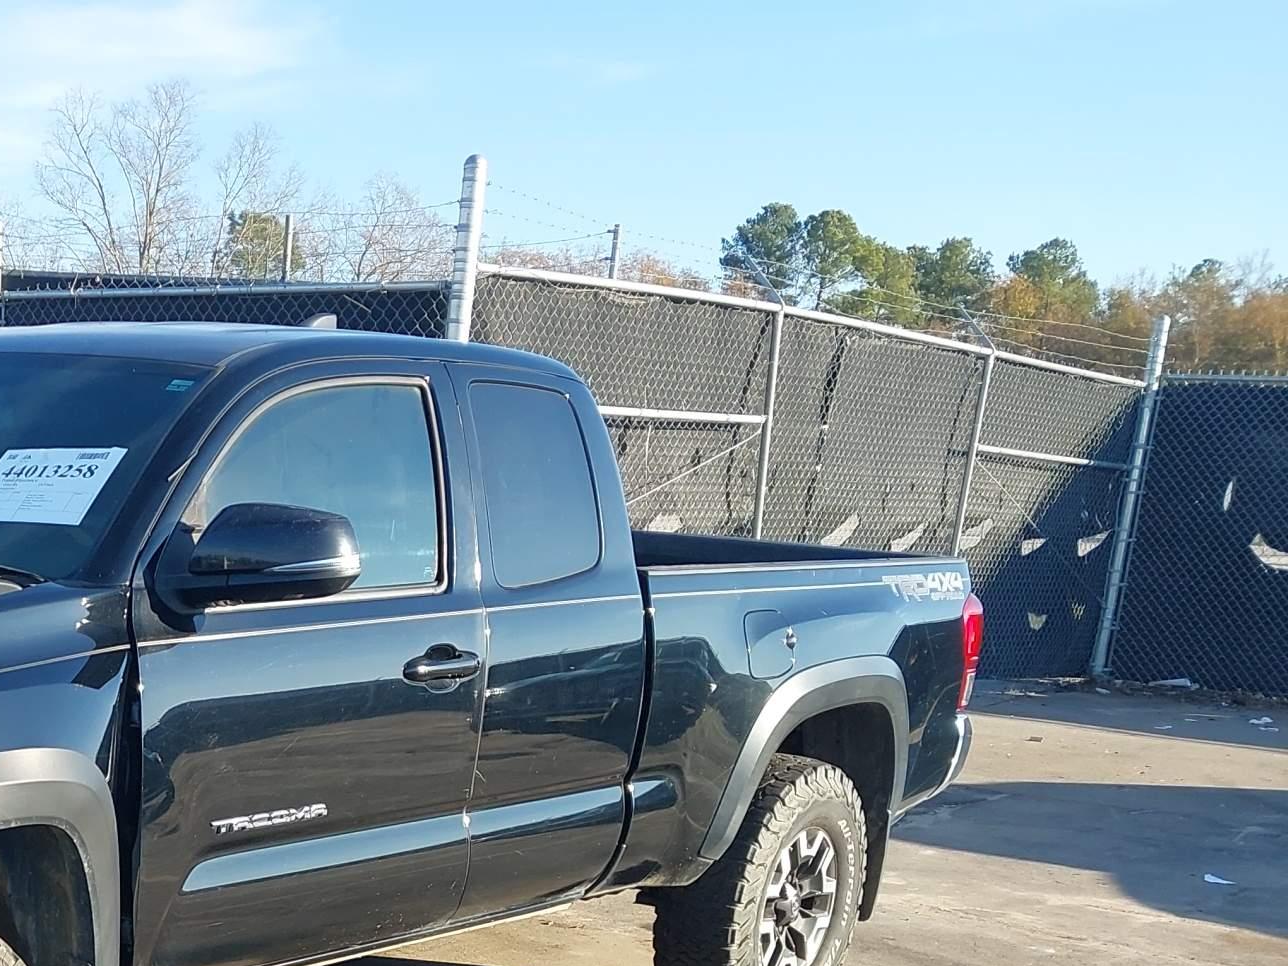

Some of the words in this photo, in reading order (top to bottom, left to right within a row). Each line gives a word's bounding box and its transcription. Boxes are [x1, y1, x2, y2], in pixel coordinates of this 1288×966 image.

[1, 463, 99, 479] 44013258
[882, 574, 929, 602] TRD
[210, 802, 328, 832] TACOMA
